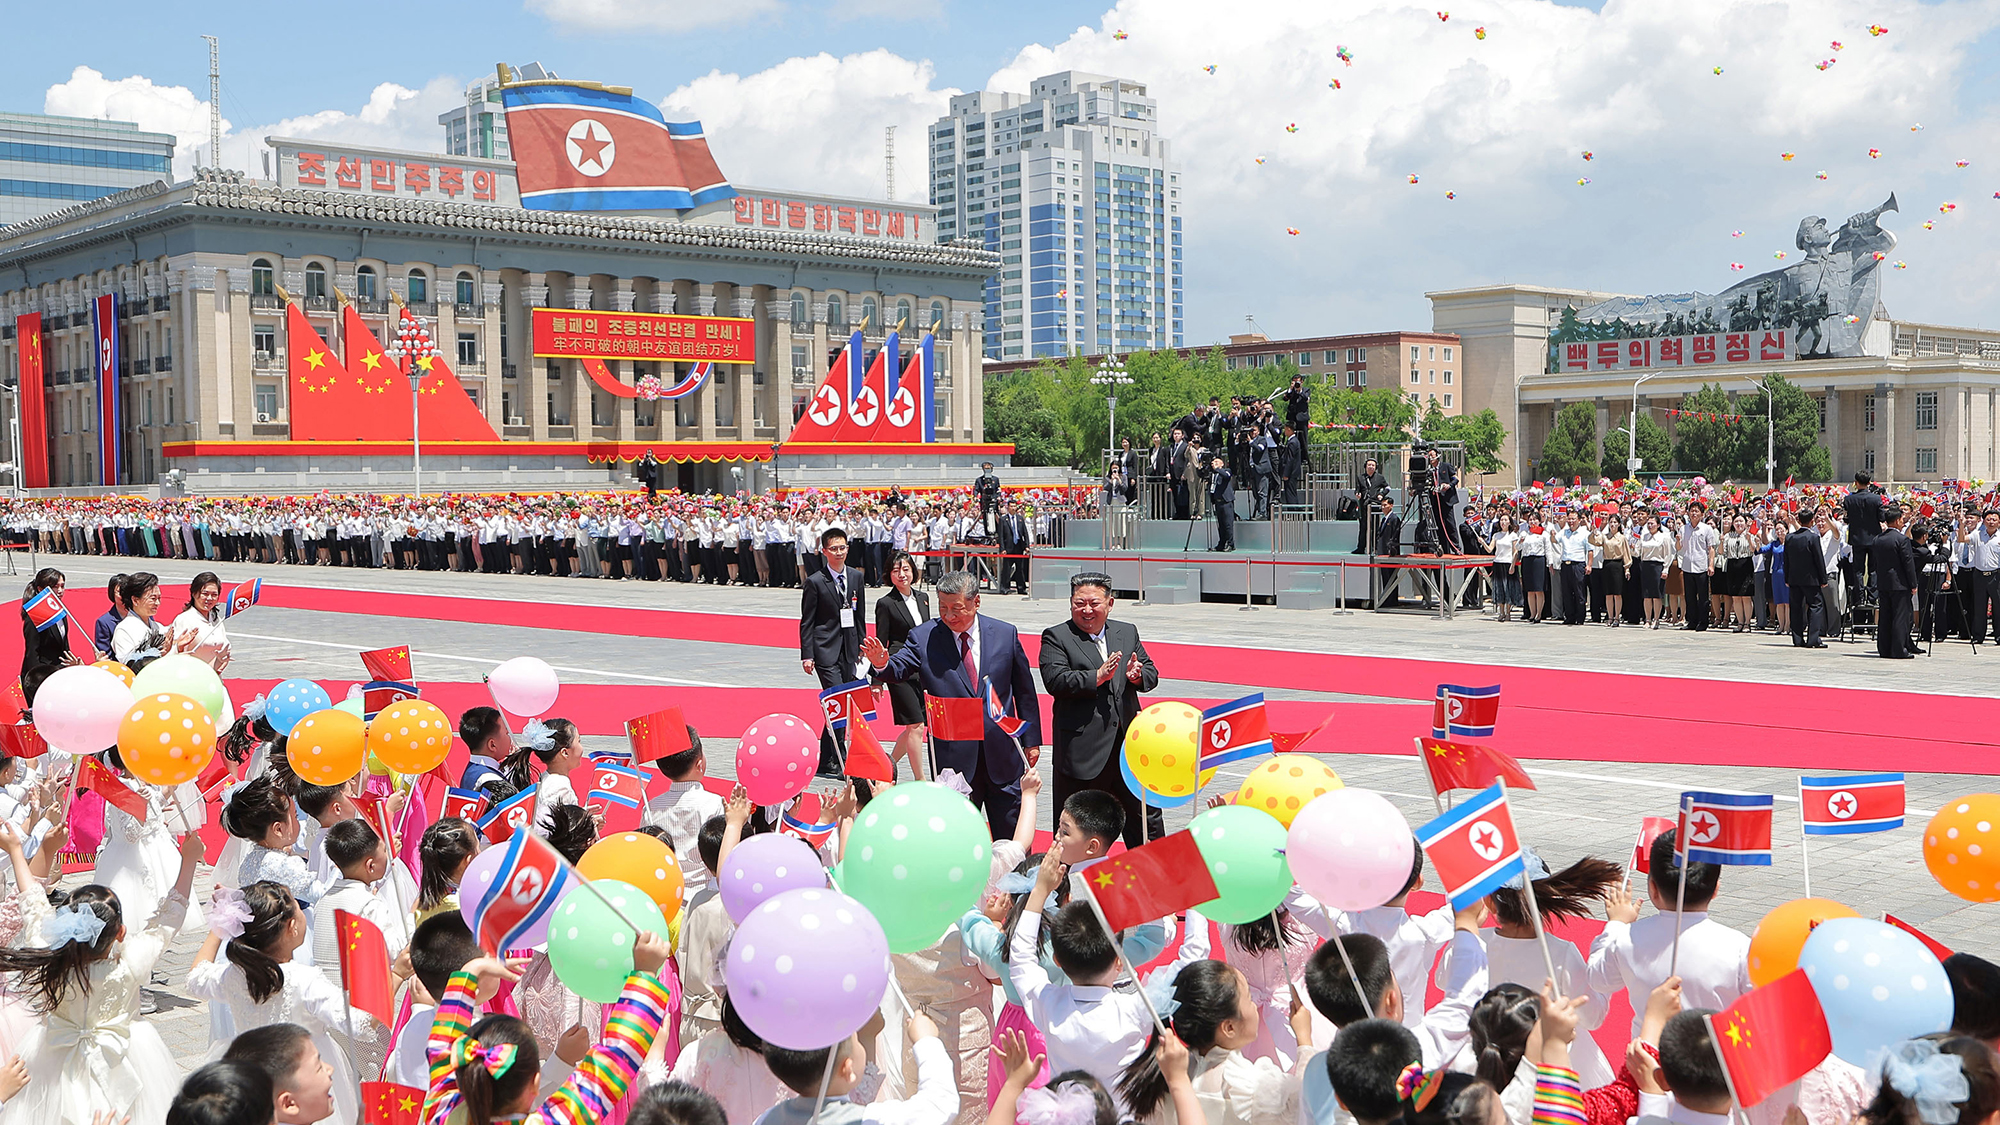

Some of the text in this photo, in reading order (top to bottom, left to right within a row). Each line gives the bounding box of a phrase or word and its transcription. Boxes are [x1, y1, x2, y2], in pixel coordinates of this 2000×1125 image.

[298, 152, 496, 201] 조선민주주의
[552, 317, 741, 341] 불패의 조중친선단결 만세!
